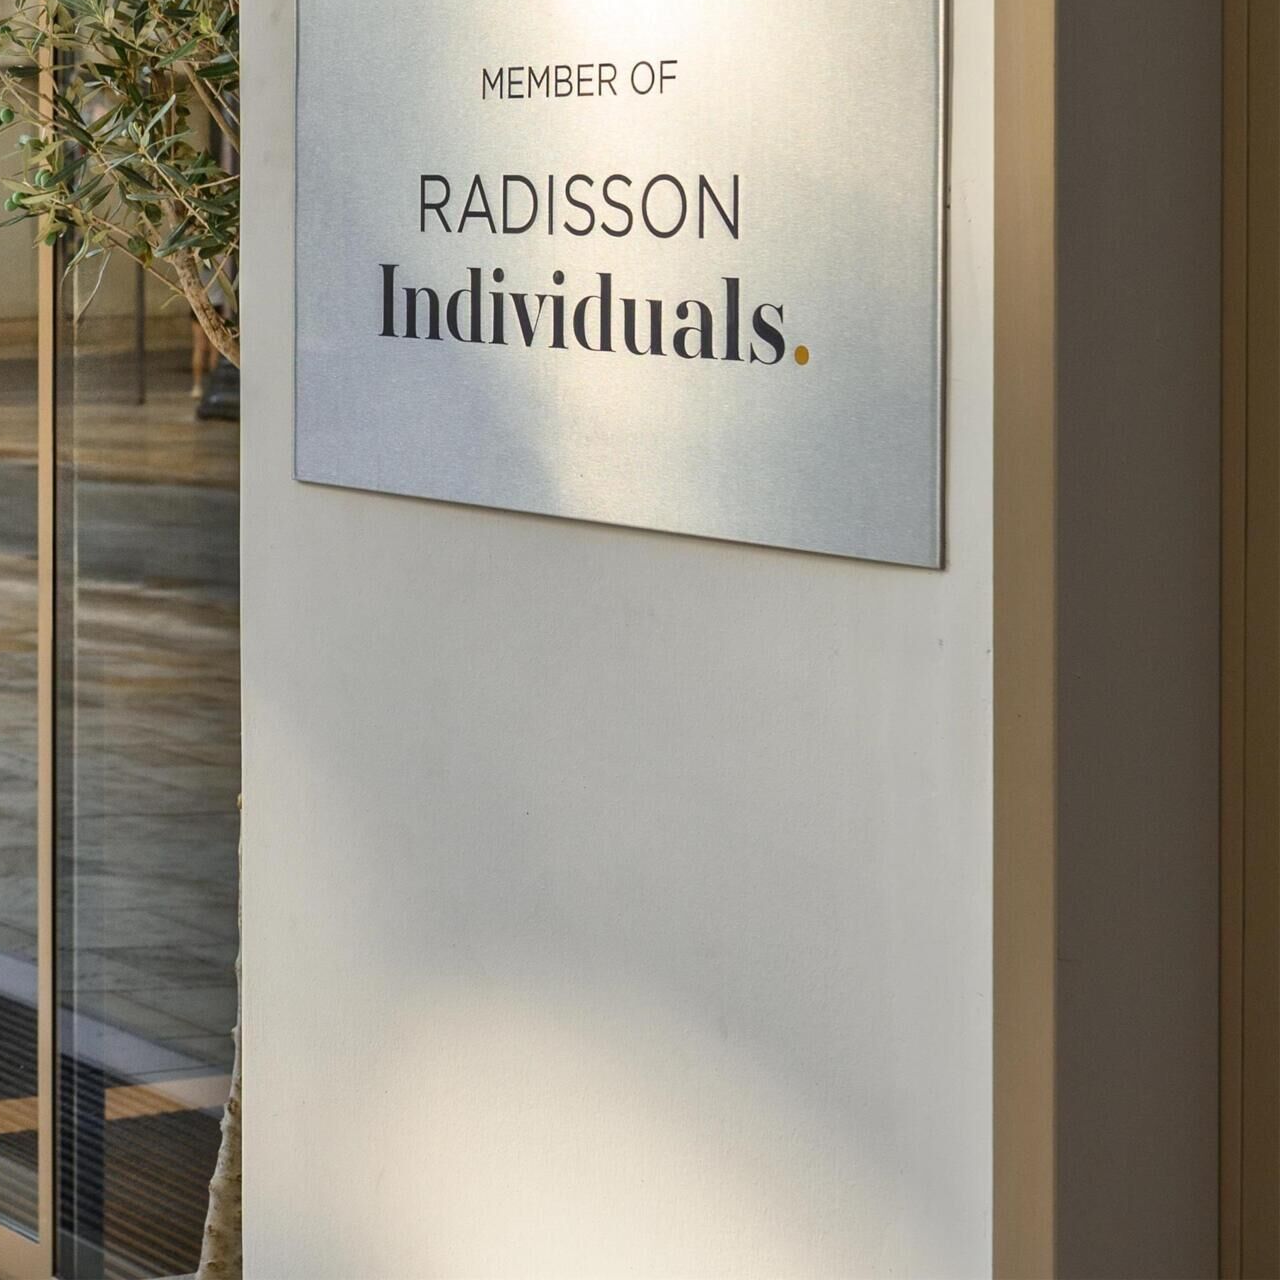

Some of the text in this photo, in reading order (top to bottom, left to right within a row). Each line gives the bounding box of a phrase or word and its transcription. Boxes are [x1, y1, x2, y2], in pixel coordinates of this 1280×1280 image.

[481, 59, 679, 101] MEMBER OF
[420, 173, 740, 241] RADISSON
[378, 263, 810, 366] Individuals.
